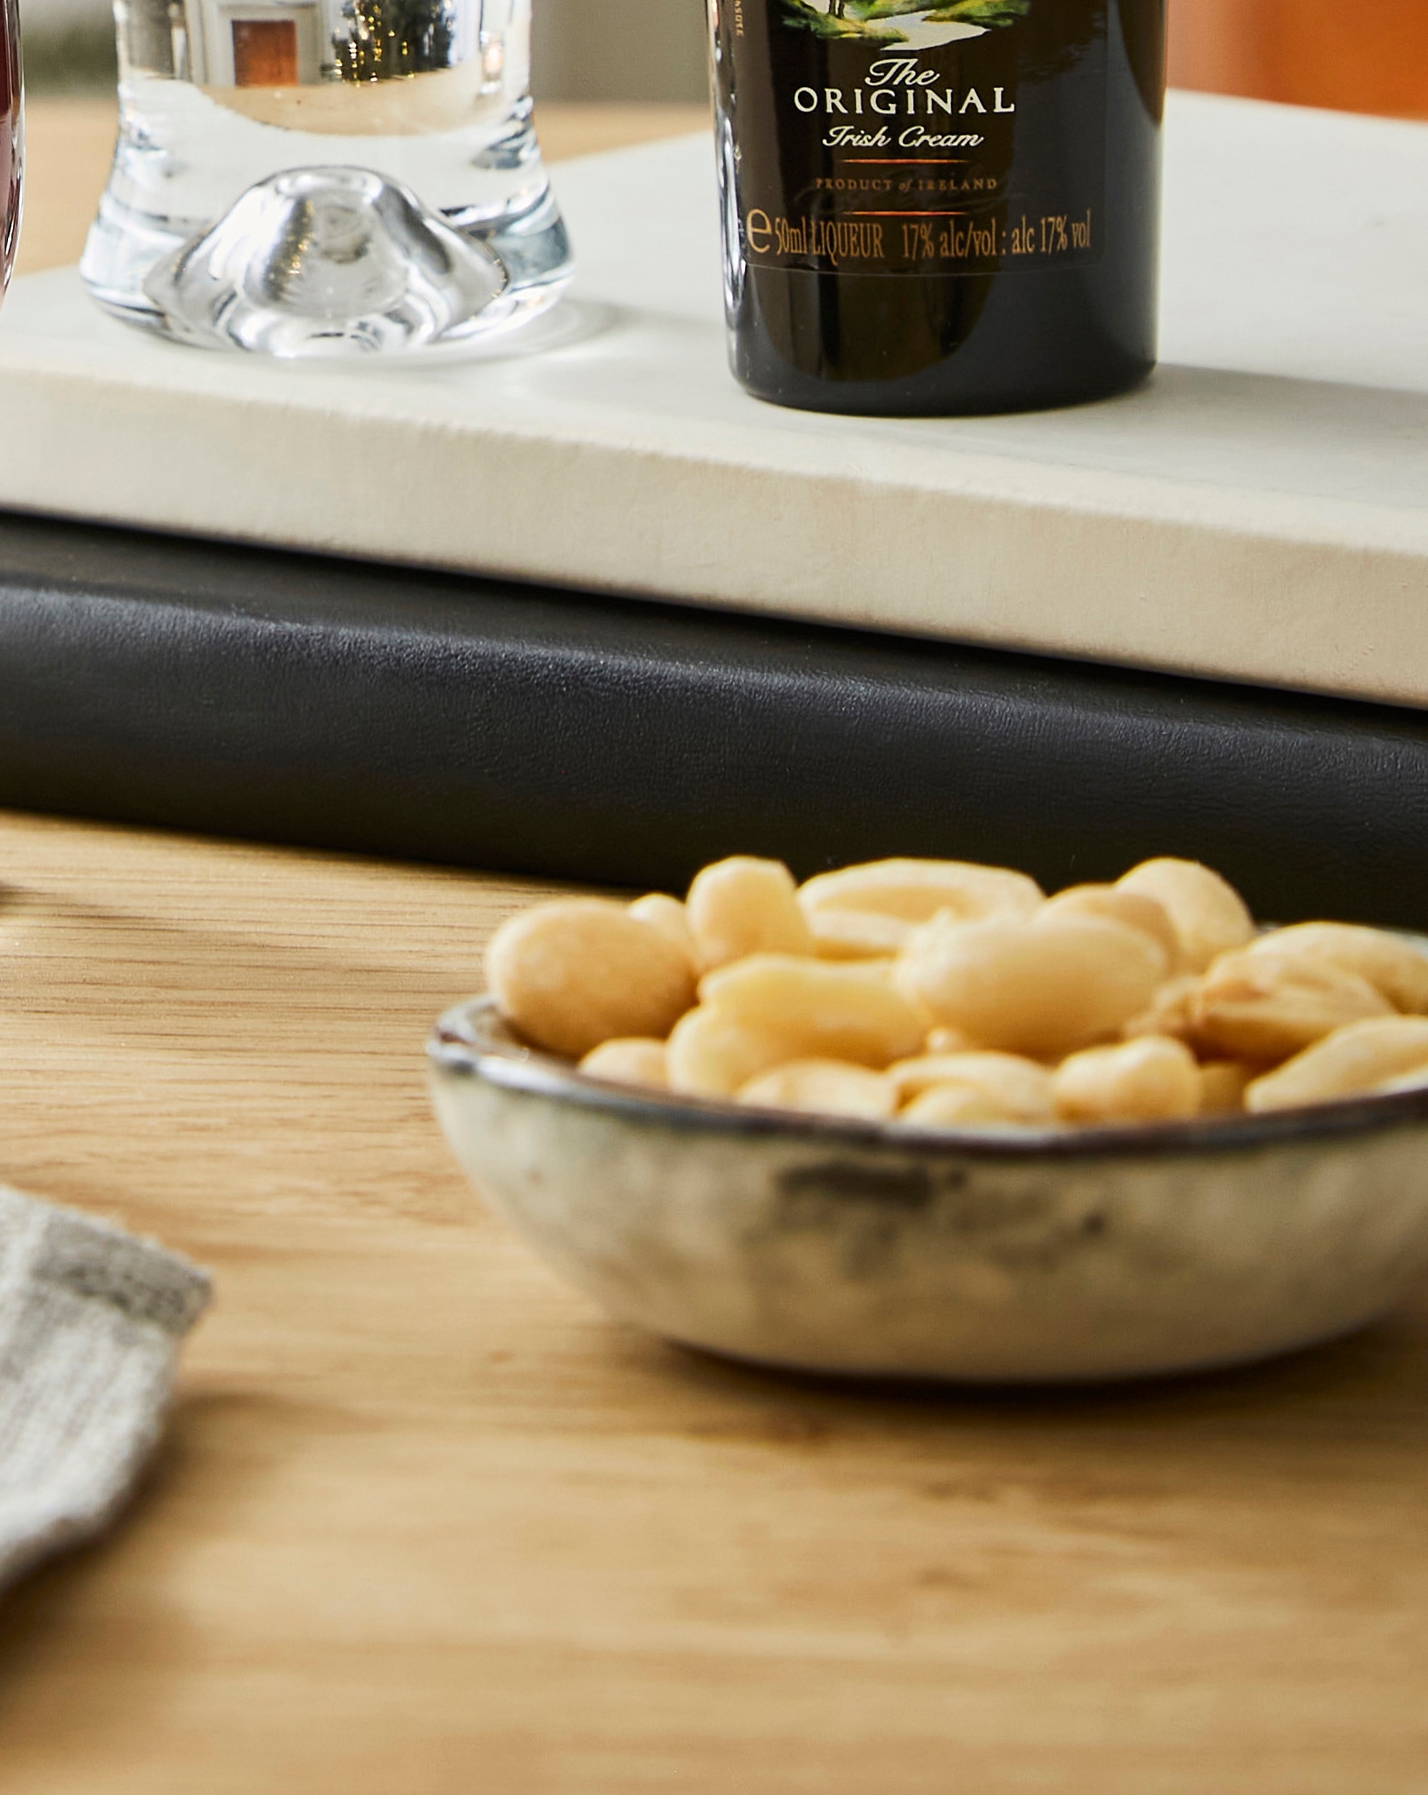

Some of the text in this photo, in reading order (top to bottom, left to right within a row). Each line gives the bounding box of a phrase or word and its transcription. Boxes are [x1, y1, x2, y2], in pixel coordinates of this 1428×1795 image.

[864, 58, 941, 86] The
[793, 86, 1016, 115] ORIGINAL
[822, 125, 984, 148] Irish Cream
[815, 177, 998, 194] PRODUCT of IRELAND
[774, 215, 809, 256] 50ml
[810, 217, 885, 267] LIQUEUR
[902, 221, 935, 262] 17%
[1011, 214, 1036, 255] alc
[1040, 214, 1069, 256] 17%
[1071, 207, 1092, 249] vol
